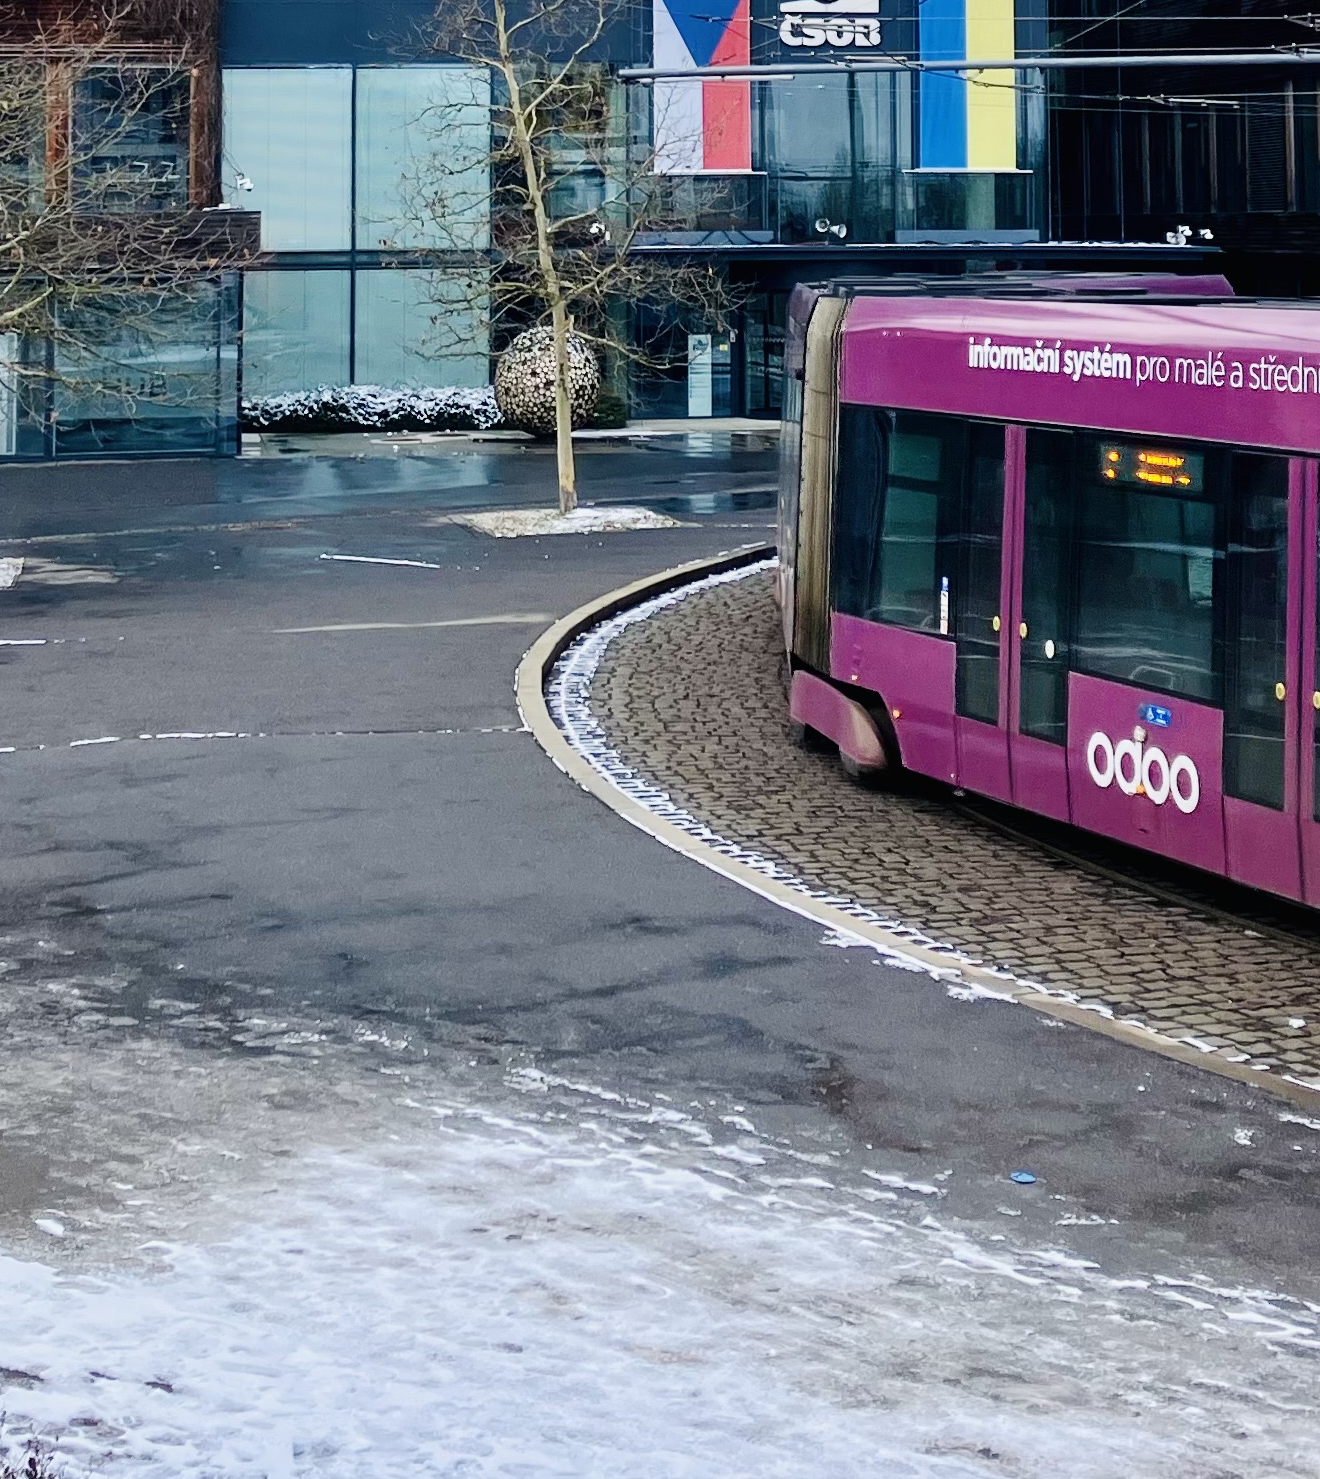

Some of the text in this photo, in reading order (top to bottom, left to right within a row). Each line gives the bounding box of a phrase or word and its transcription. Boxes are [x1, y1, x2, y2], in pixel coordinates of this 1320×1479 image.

[779, 13, 881, 47] ČSOB
[968, 336, 1062, 374] informační
[1063, 343, 1132, 382] systém
[1135, 354, 1170, 387] pro
[1174, 351, 1226, 387] malé
[1229, 361, 1244, 388] a
[1087, 729, 1200, 814] odoo
